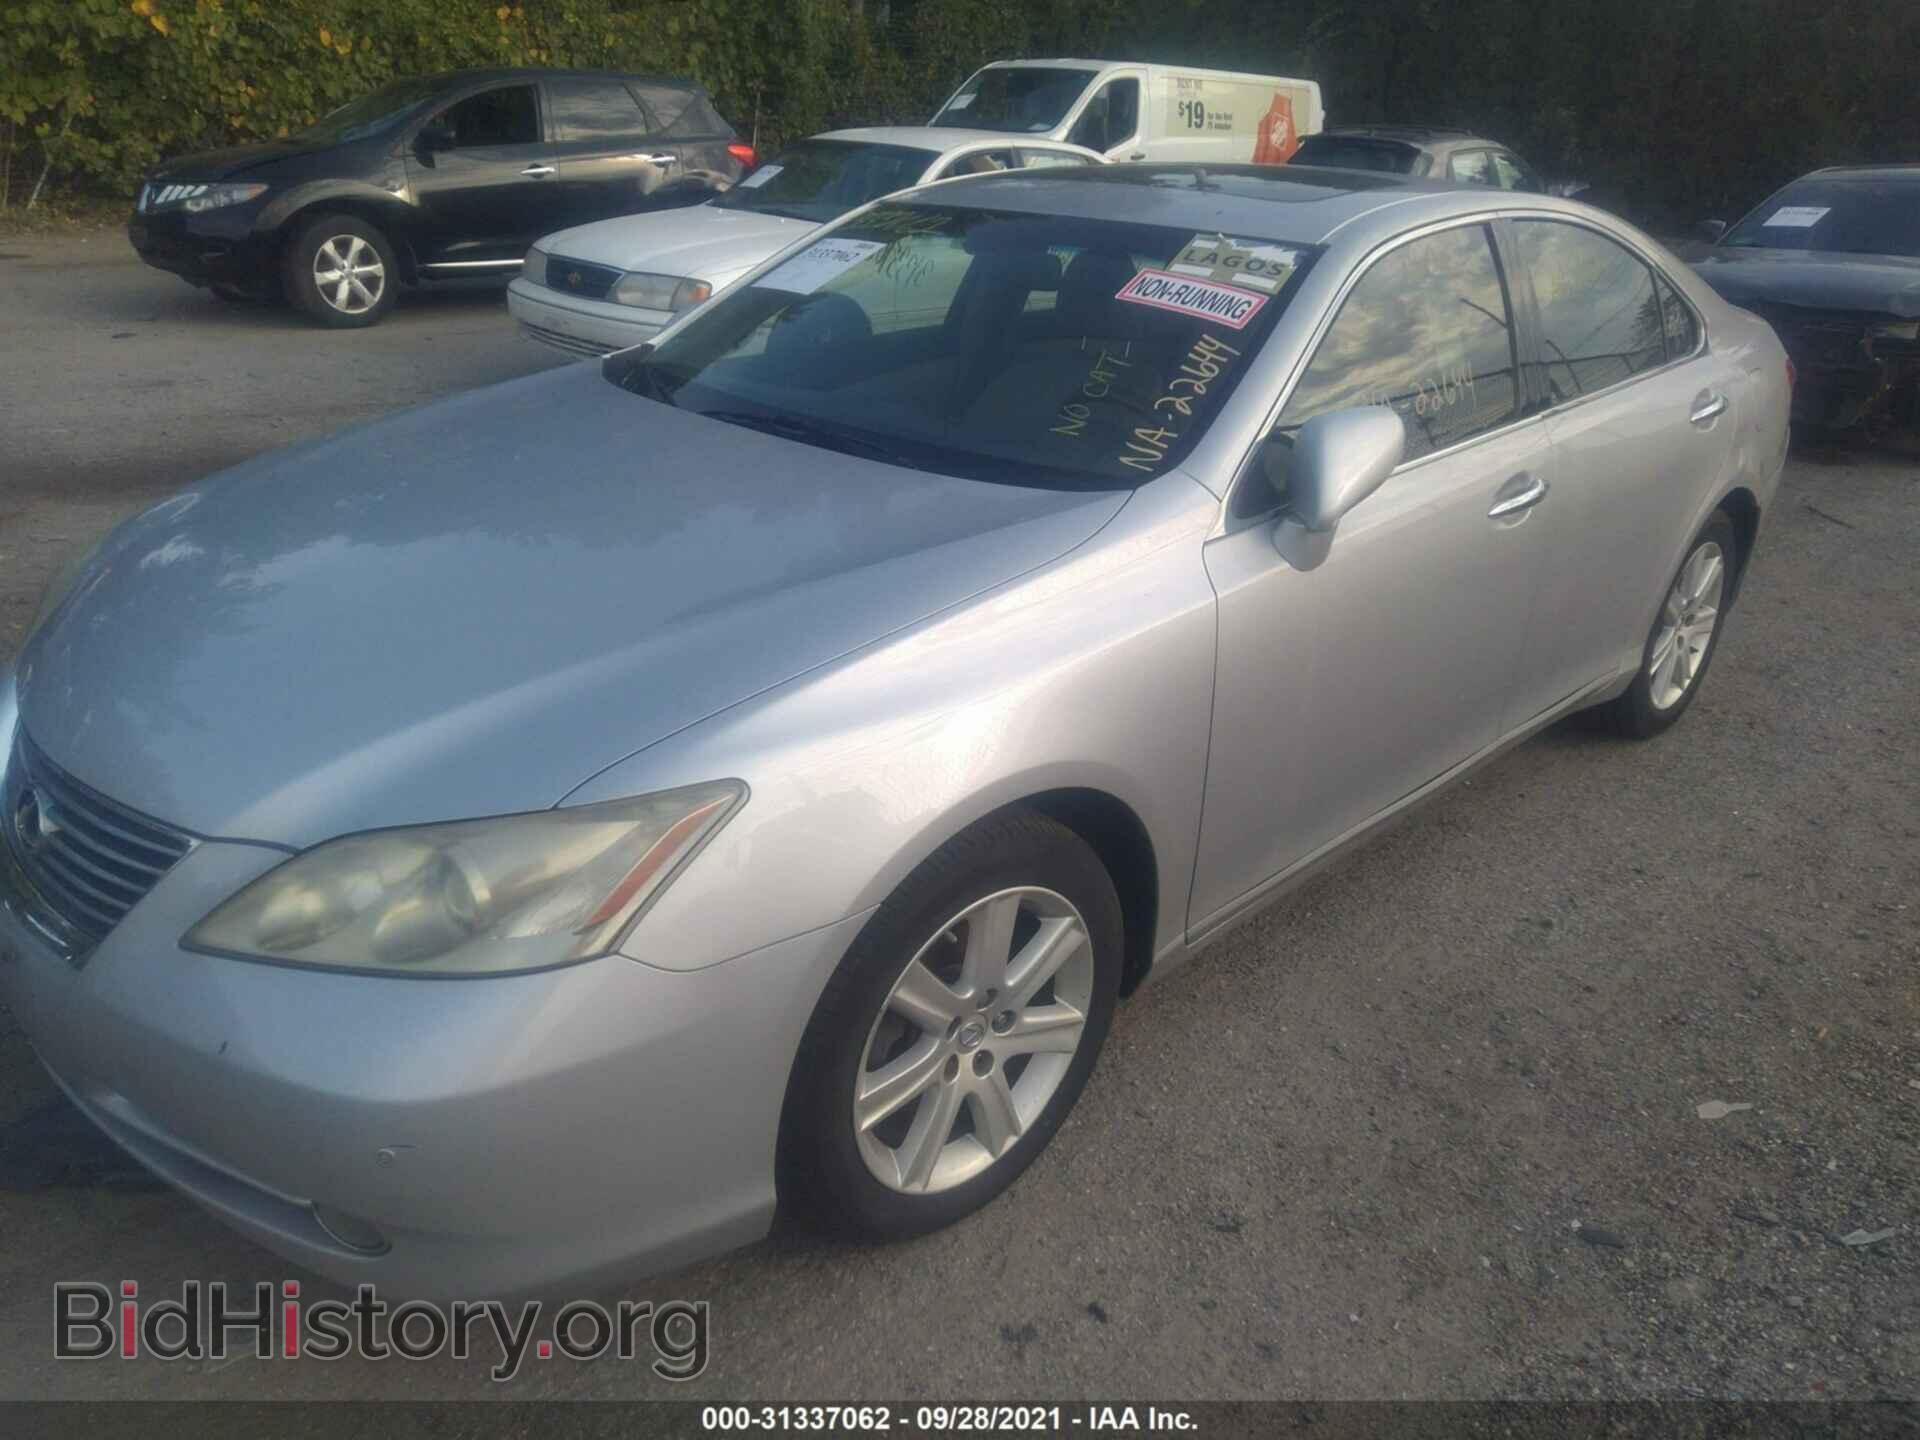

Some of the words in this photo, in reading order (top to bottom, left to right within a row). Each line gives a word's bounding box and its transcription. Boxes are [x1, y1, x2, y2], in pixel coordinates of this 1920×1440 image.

[1178, 100, 1205, 129] $19
[1183, 249, 1286, 277] LAGOS
[1132, 276, 1252, 320] NON-RUNNING
[1049, 403, 1091, 436] NO
